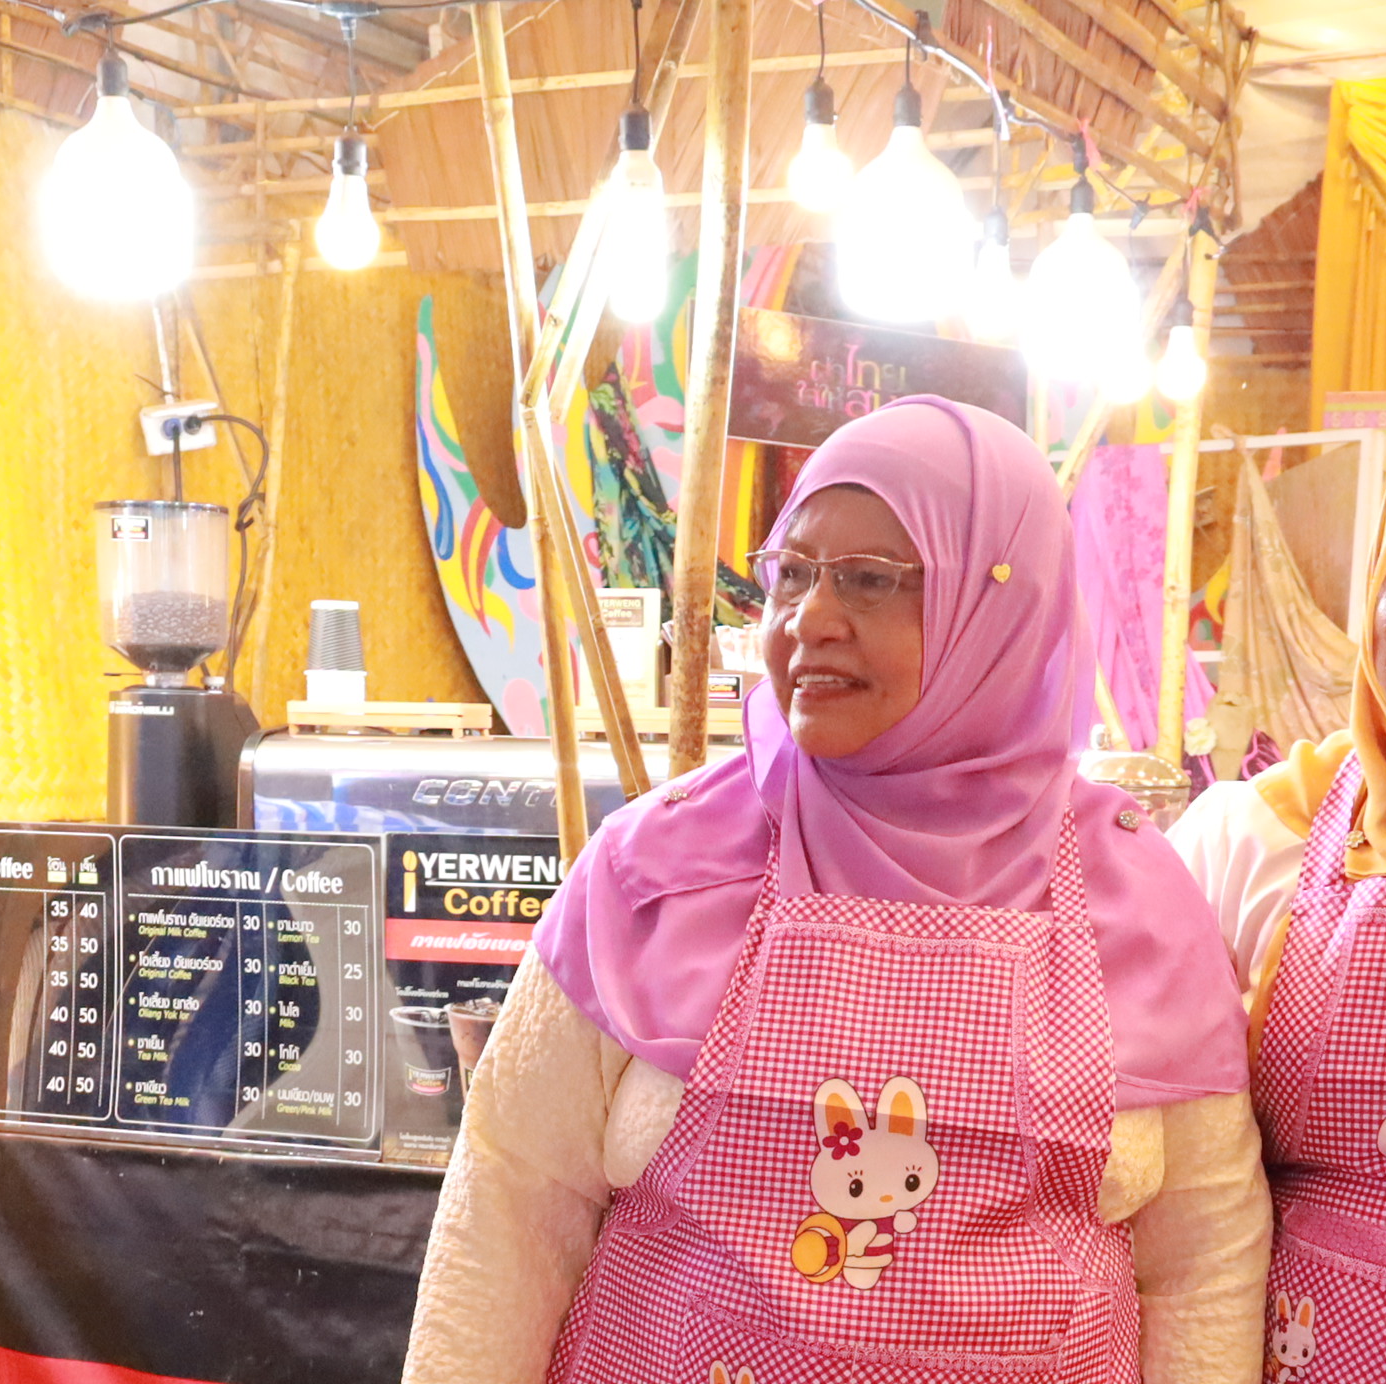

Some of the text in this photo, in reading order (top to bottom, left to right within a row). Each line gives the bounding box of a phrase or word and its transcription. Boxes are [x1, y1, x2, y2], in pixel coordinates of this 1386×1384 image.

[412, 779, 558, 808] CONT
[150, 861, 261, 891] กาแฟโบราณ
[281, 869, 344, 895] Coffee
[50, 901, 69, 918] 35
[79, 902, 99, 919] 40
[243, 915, 261, 931] 30
[344, 919, 362, 935] 30
[138, 924, 208, 939] Original Milk Coffee
[277, 934, 320, 944] Lemon Tea
[50, 936, 69, 952] 35
[79, 938, 99, 954] 50
[138, 967, 193, 981] Original Coffee
[243, 958, 262, 974] 30
[343, 963, 363, 980] 25
[50, 970, 69, 987] 35
[79, 972, 99, 989] 50
[278, 976, 316, 987] Black Tea
[244, 999, 262, 1015] 30
[345, 1006, 363, 1022] 30
[49, 1006, 69, 1023] 40
[78, 1008, 98, 1025] 50
[278, 1017, 295, 1029] Milo
[48, 1040, 68, 1057] 40
[76, 1042, 97, 1059] 50
[137, 1050, 169, 1062] Tea Milk
[244, 1042, 262, 1057] 30
[344, 1049, 363, 1065] 30
[277, 1060, 302, 1072] Cocoa
[46, 1076, 66, 1093] 40
[75, 1077, 95, 1094] 50
[134, 1093, 190, 1107] Green Tea Milk
[242, 1086, 260, 1102] 30
[343, 1091, 362, 1107] 30
[316, 1105, 333, 1117] Milk
